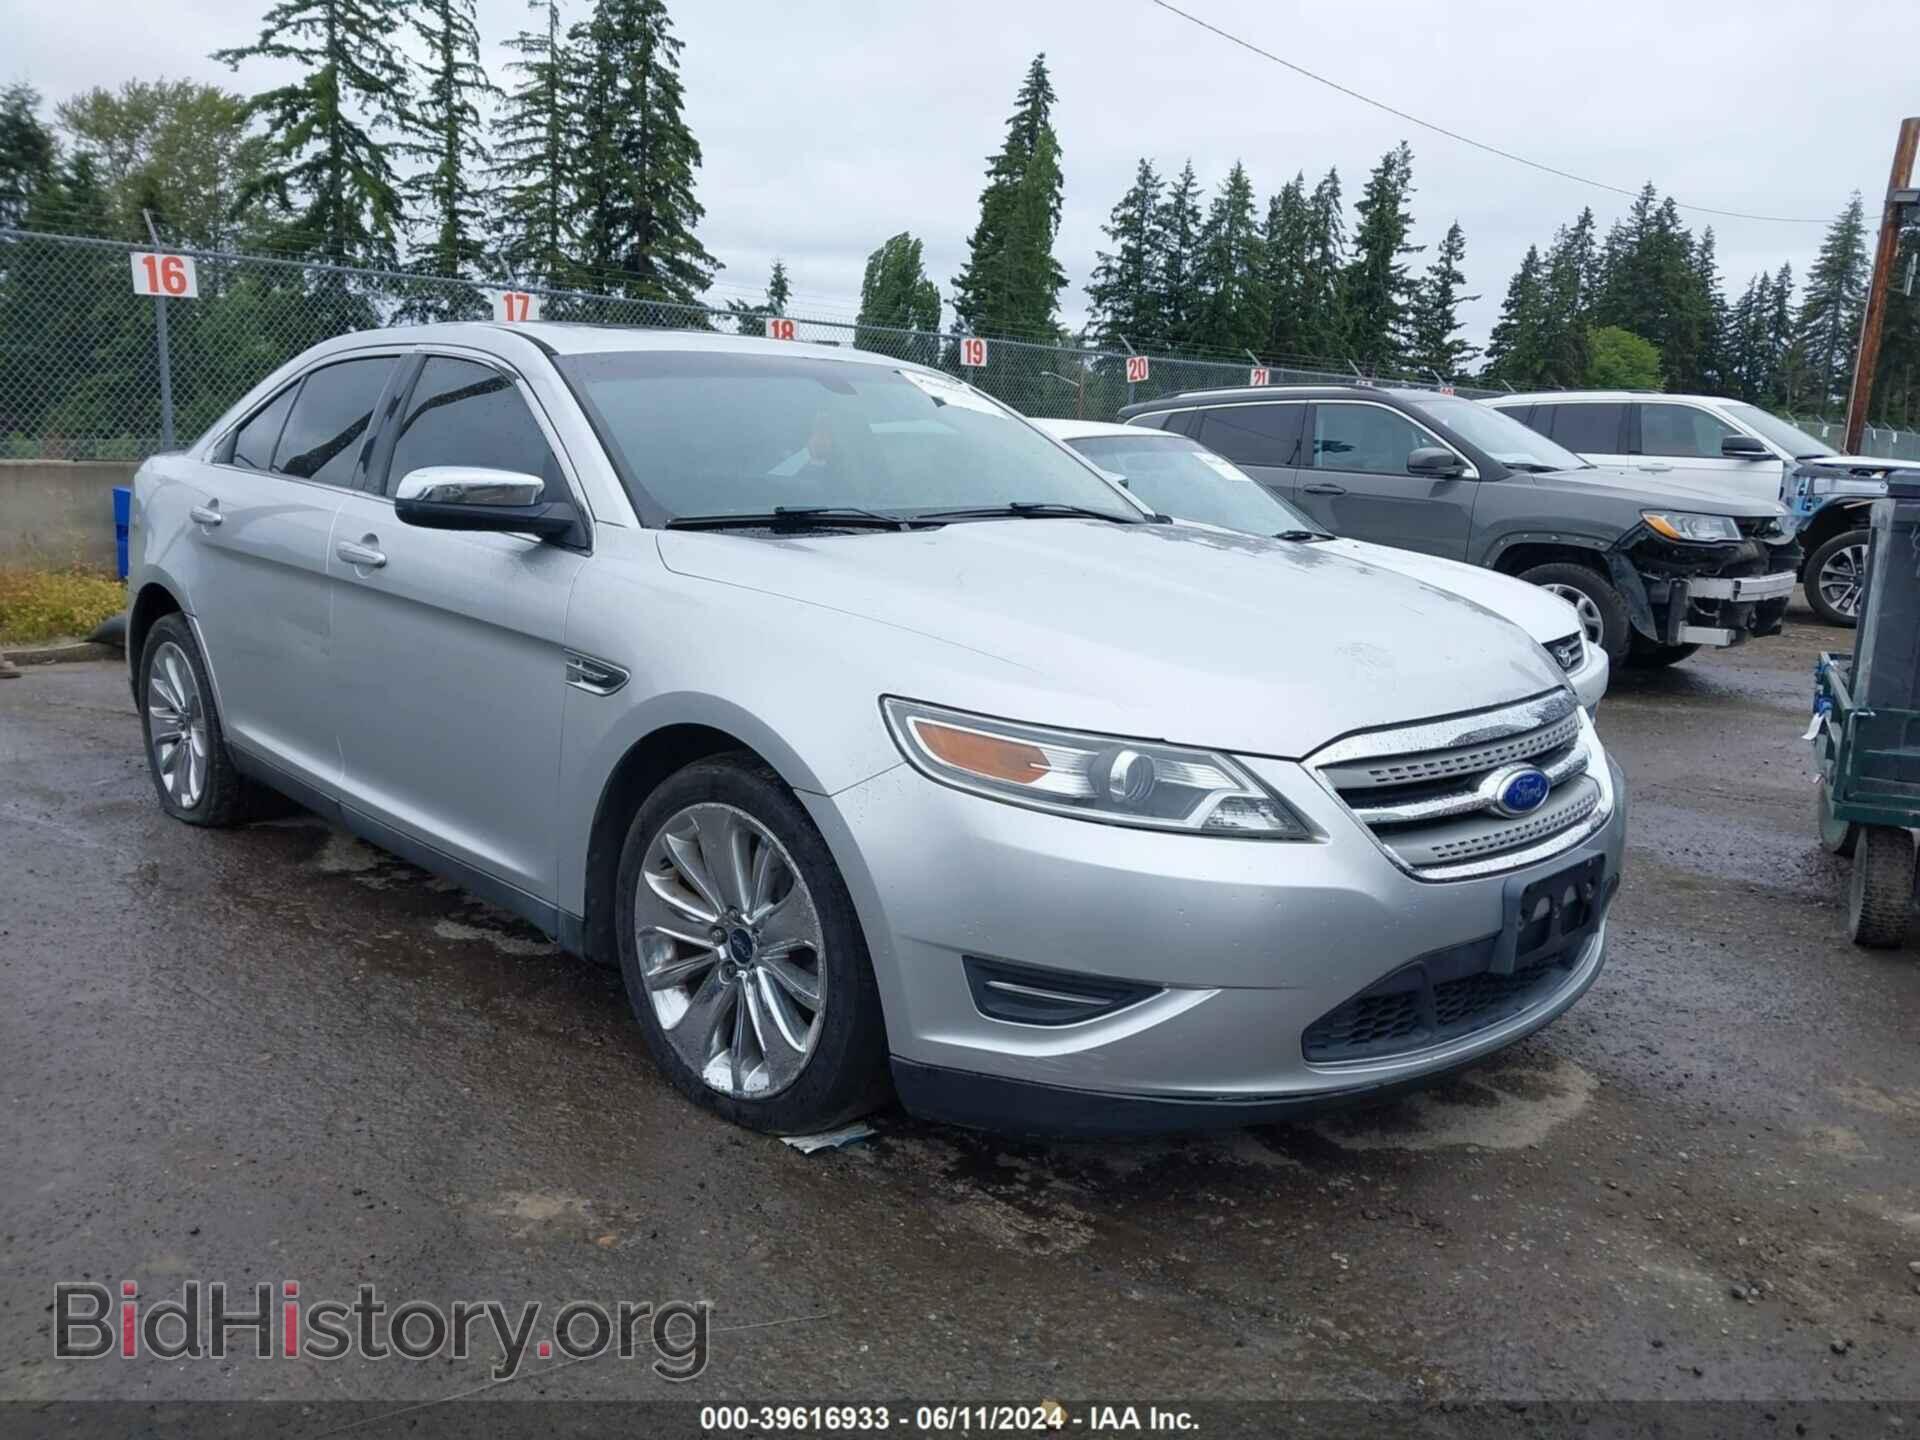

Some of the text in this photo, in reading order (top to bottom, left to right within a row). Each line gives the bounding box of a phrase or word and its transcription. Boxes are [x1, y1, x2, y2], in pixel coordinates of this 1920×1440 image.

[142, 255, 188, 295] 16
[503, 292, 530, 322] 17
[965, 340, 983, 364] 19
[1129, 358, 1147, 380] 20
[1254, 370, 1266, 385] 21
